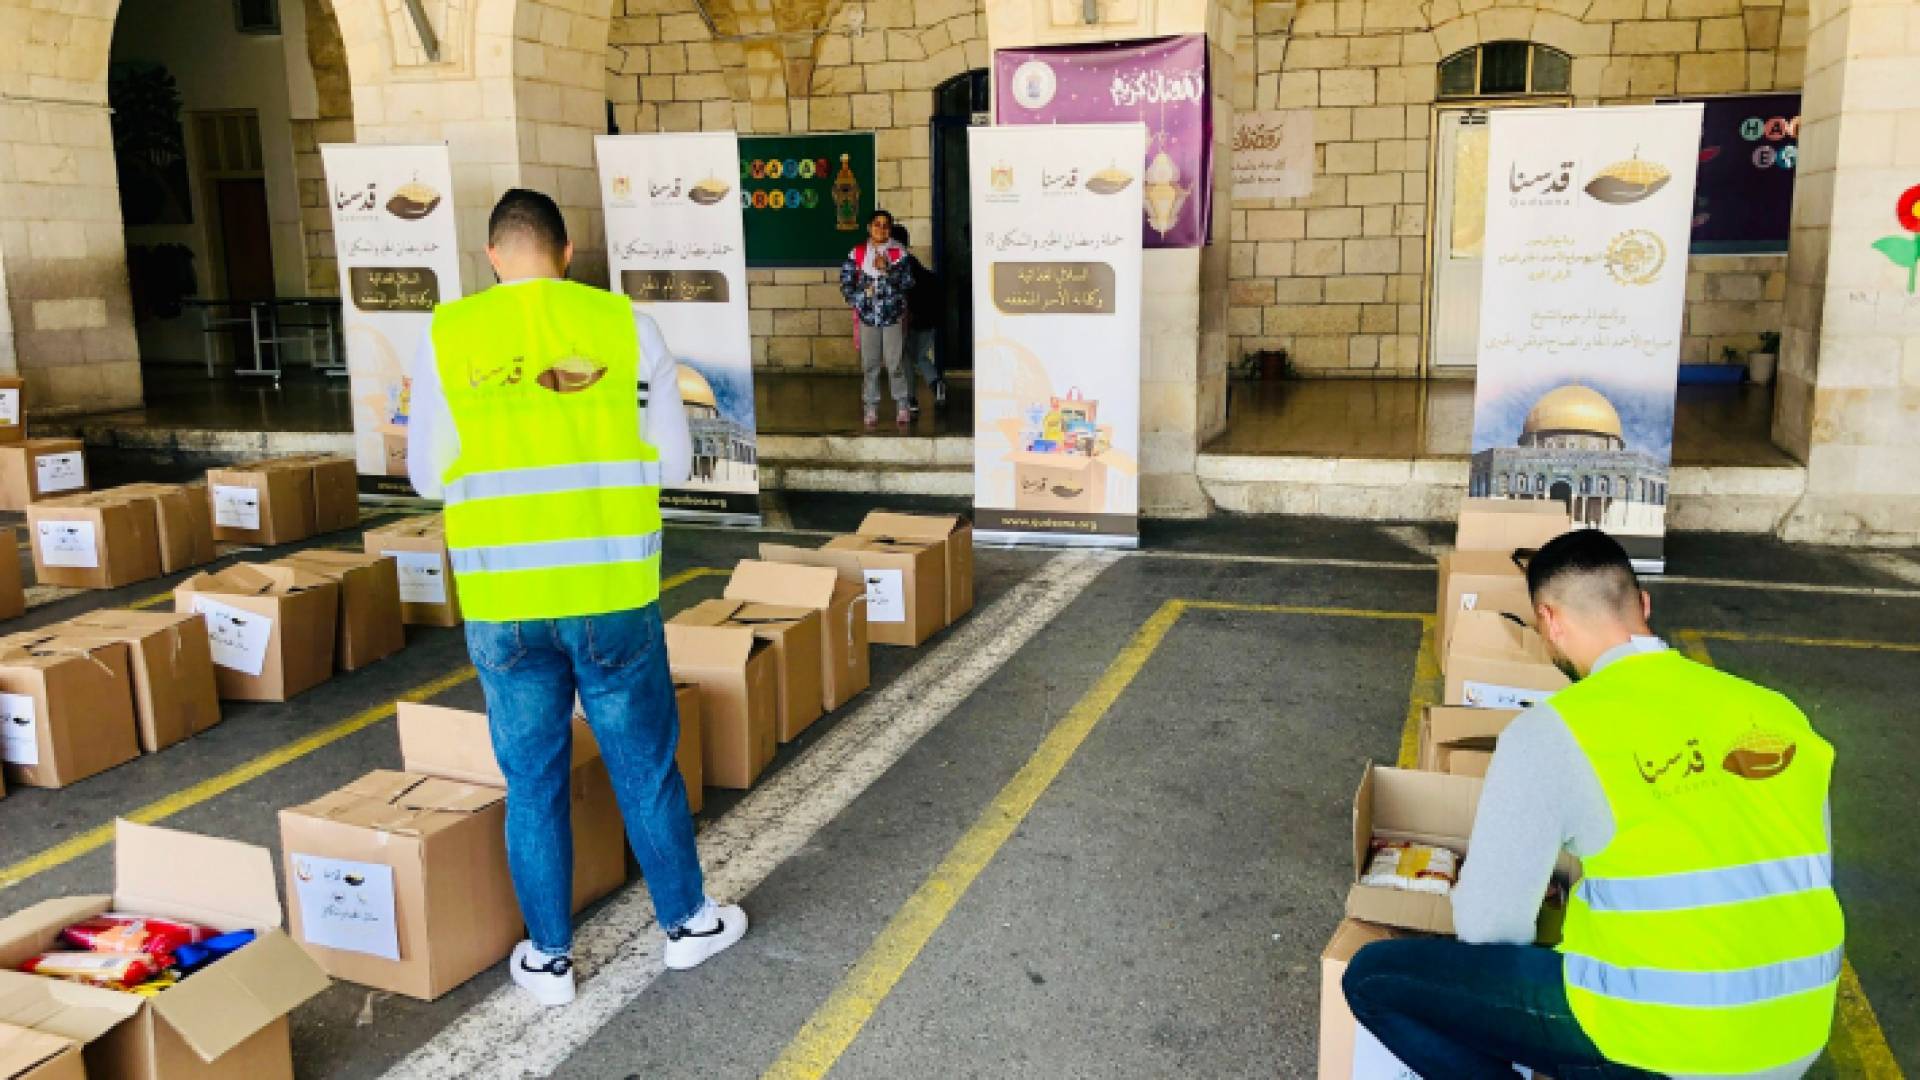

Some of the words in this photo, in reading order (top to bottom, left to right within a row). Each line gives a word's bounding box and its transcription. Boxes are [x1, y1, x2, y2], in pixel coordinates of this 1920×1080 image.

[1042, 167, 1078, 188] قدسنا
[1509, 160, 1575, 194] قدسنا
[335, 181, 376, 211] قدسنا
[467, 355, 524, 388] قدسنا
[1634, 738, 1704, 783] قدسنا
